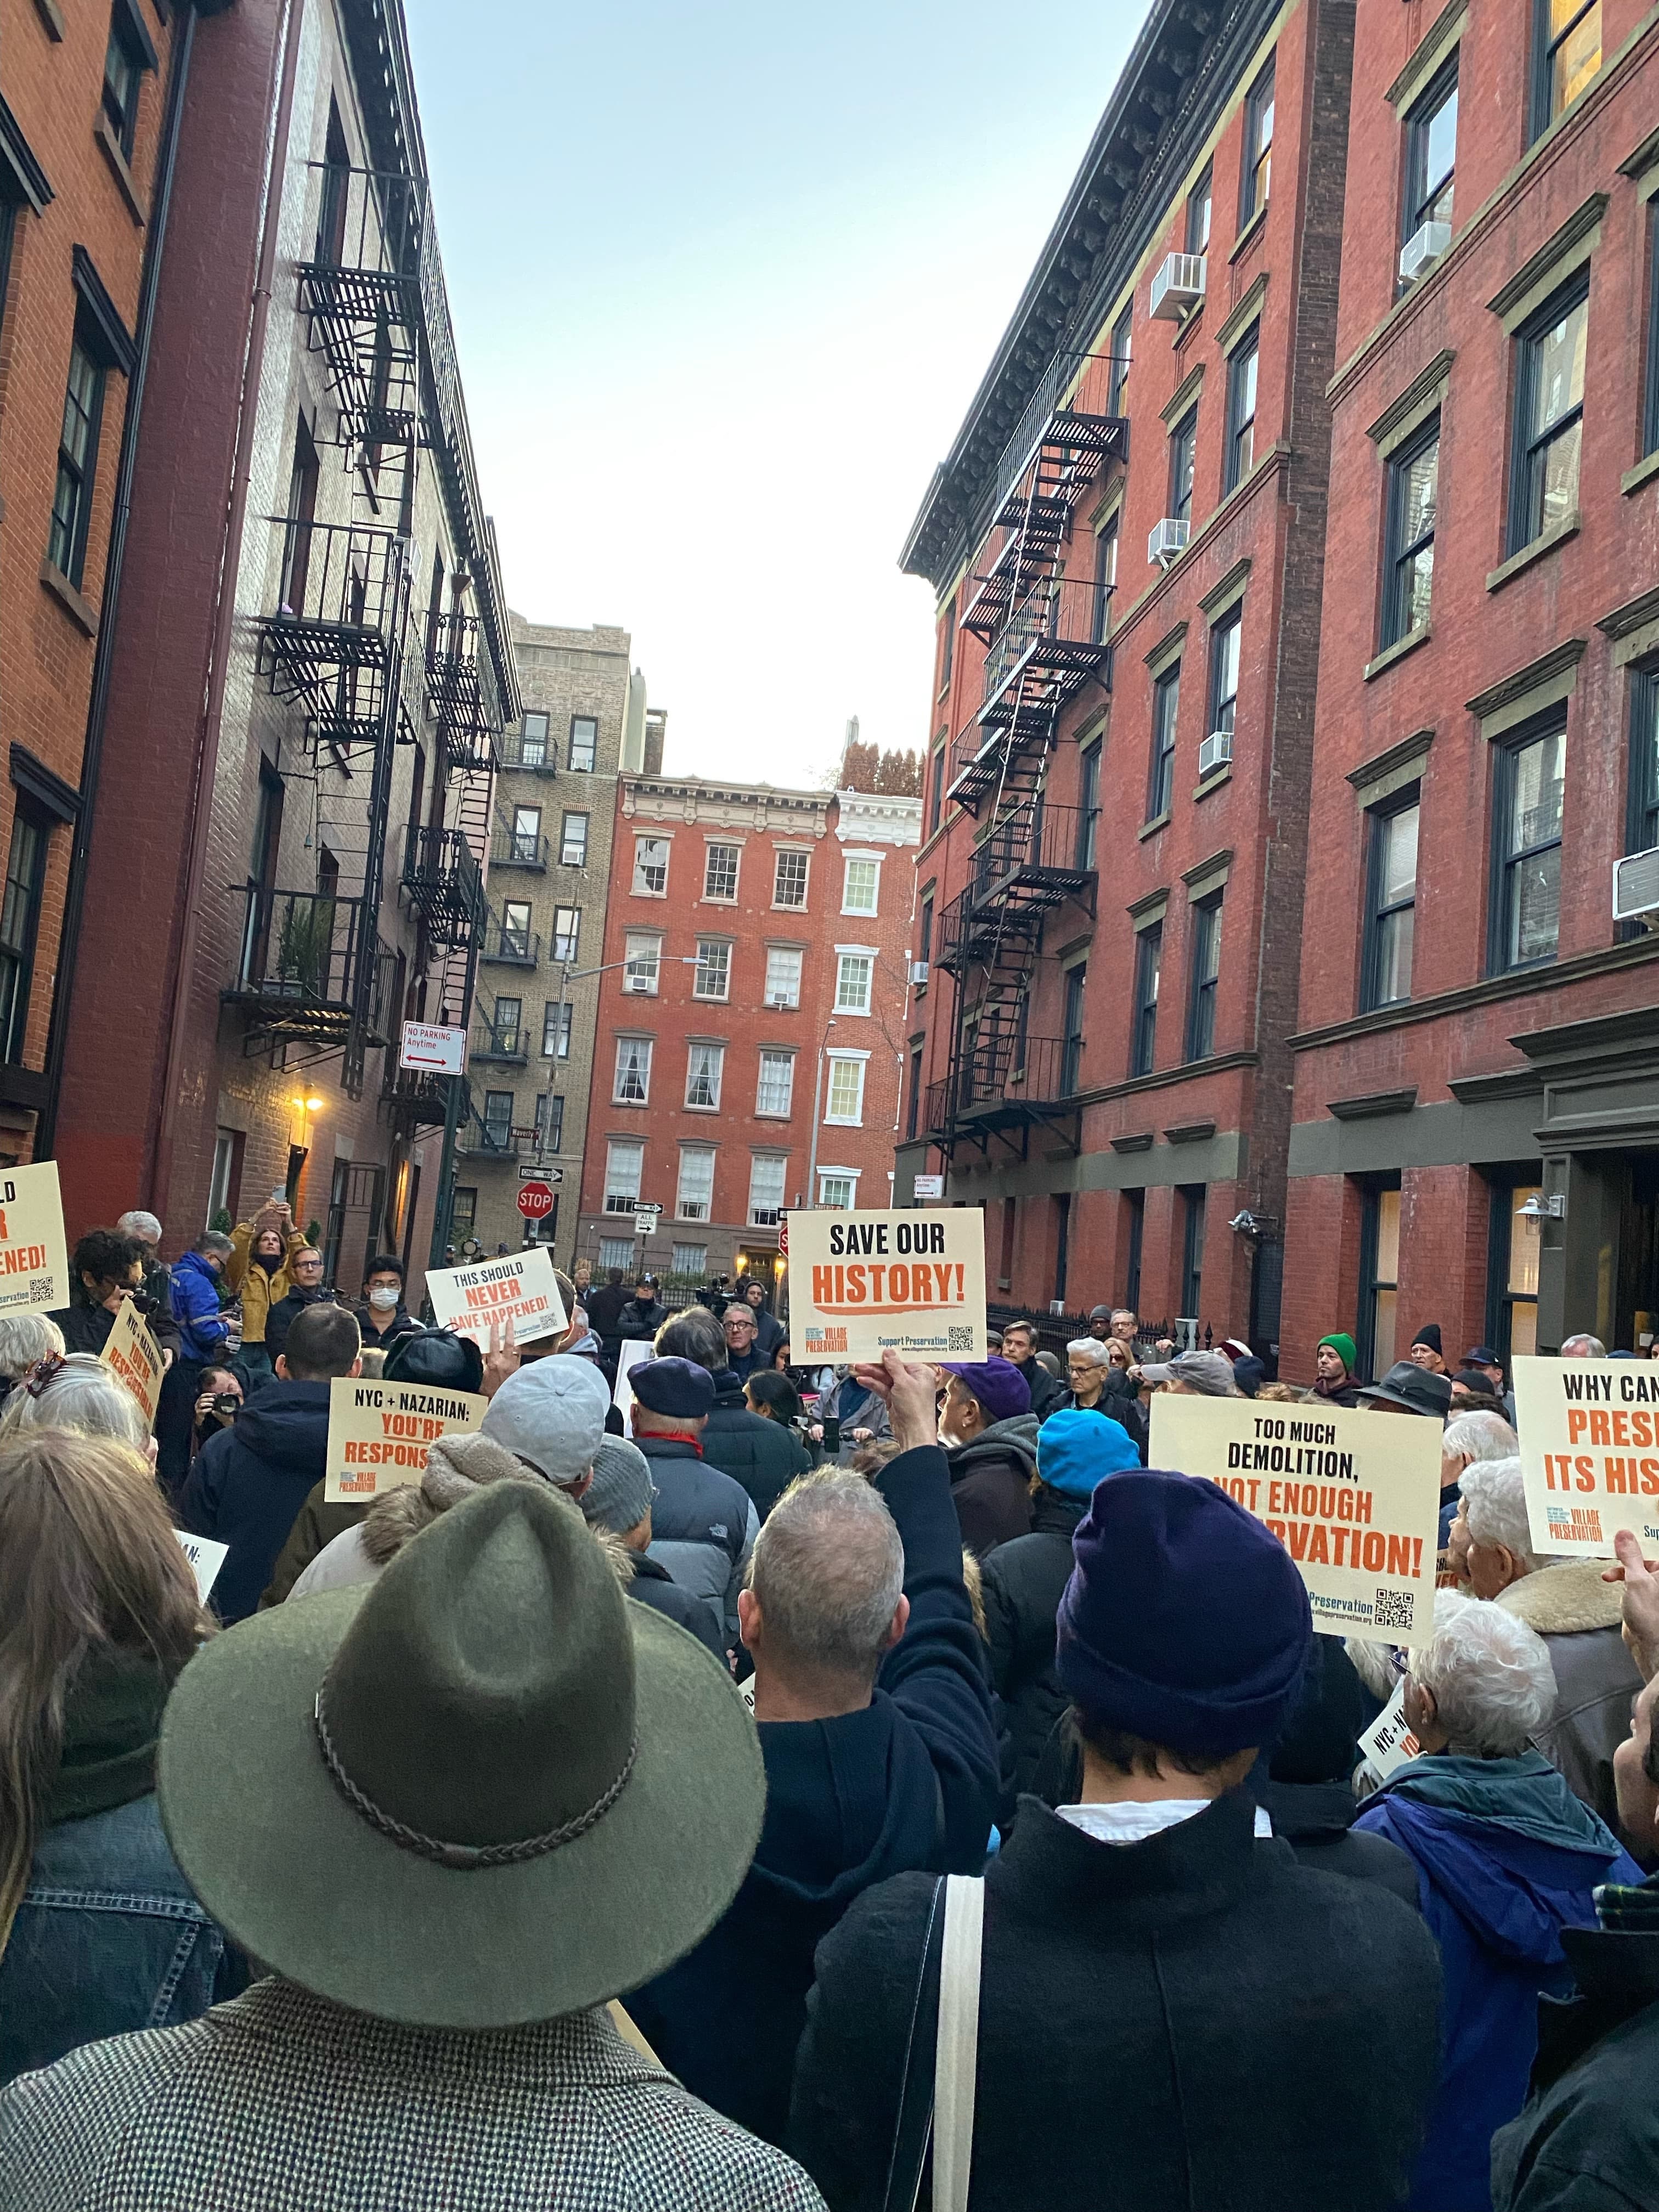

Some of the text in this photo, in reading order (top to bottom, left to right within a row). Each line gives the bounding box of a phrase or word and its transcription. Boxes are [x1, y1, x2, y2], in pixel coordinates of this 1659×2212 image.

[407, 1037, 437, 1049] Anytime
[408, 1028, 450, 1041] NO PARKING
[512, 1128, 533, 1138] Waverly
[520, 1192, 551, 1209] STOP
[830, 1223, 945, 1255] SAVE OUR
[453, 1261, 524, 1288] THIS SHOULD
[812, 1263, 964, 1304] HISTORY!
[465, 1278, 522, 1307] NEVER
[126, 1312, 138, 1336] NYC
[449, 1295, 549, 1330] HAVE HAPPENED!
[806, 1340, 848, 1353] PRESERVATION
[825, 1327, 847, 1340] VILLAGE
[878, 1336, 947, 1348] Support Preservation
[1562, 1374, 1612, 1401] WHY
[355, 1389, 470, 1422] NYC + NAZARIAN:
[382, 1413, 444, 1441] YOU'RE
[1254, 1418, 1336, 1444] TOO MUCH
[1228, 1442, 1358, 1483] DEMOLITION,
[1544, 1454, 1659, 1496] ITS HIS
[1268, 1480, 1373, 1524] ENOUGH
[1571, 1508, 1601, 1525] VILLAGE
[1549, 1523, 1603, 1543] PRESERVATION
[1310, 1592, 1373, 1615] Preservation
[1373, 1727, 1395, 1755] NYC
